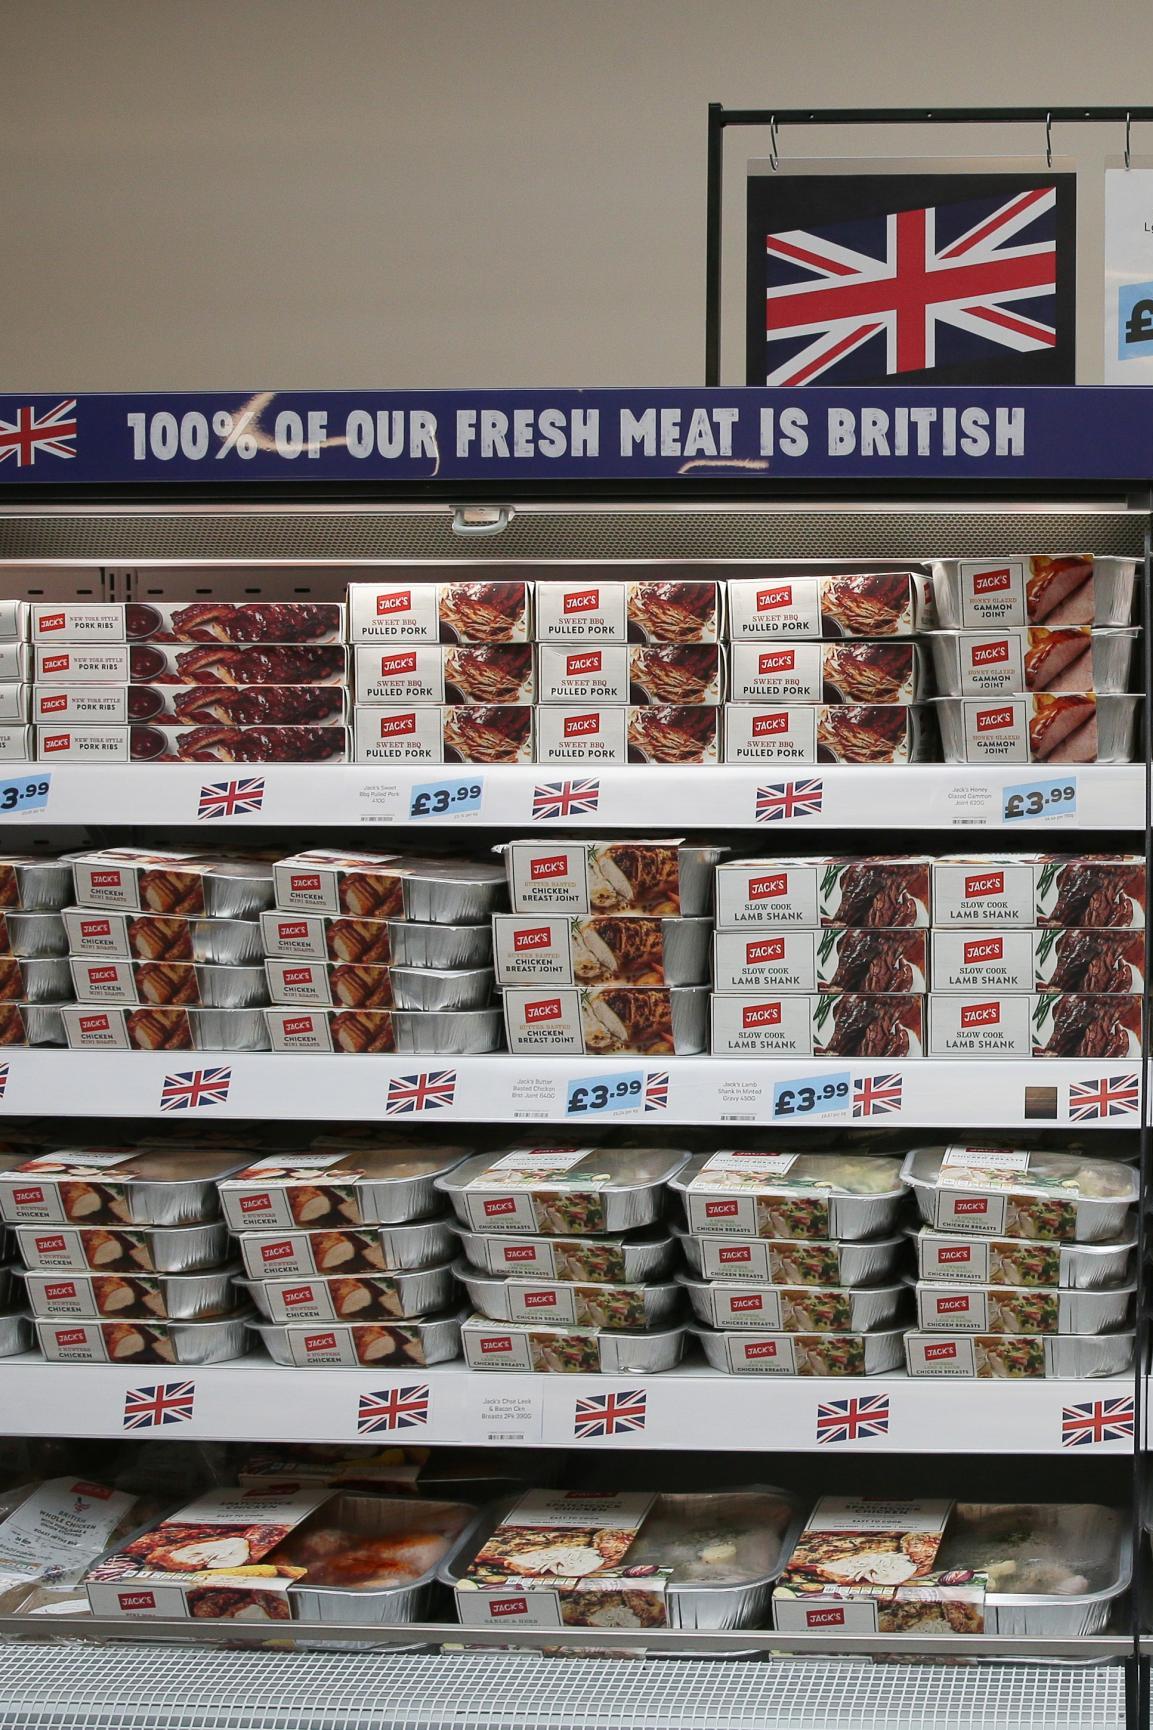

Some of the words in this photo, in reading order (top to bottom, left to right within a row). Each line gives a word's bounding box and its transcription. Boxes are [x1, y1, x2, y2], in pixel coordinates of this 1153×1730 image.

[127, 410, 260, 461] 100%
[276, 410, 327, 459] OF
[346, 410, 440, 459] OUR
[456, 409, 600, 459] FRESH
[620, 408, 738, 457] MEAT
[759, 407, 808, 458] IS
[827, 407, 1025, 457] BRITISH
[977, 575, 1007, 589] JACK'S
[379, 596, 408, 610] JACK'S
[41, 618, 64, 628] JACK'S
[362, 627, 397, 635] PULLED
[401, 627, 427, 635] PORK
[411, 785, 482, 816] £3.99
[1004, 786, 1076, 819] £3.99
[534, 862, 565, 874] JACK'S
[91, 888, 124, 897] CHICKEN
[752, 880, 785, 894] JACK'S
[734, 912, 763, 921] LAMB
[766, 912, 804, 921] SHANK
[567, 1080, 642, 1113] £3.99
[774, 1082, 849, 1116] £3.99
[242, 1198, 268, 1208] JACK'S
[708, 1205, 736, 1214] JACK'S
[810, 1612, 841, 1623] JACK'S
